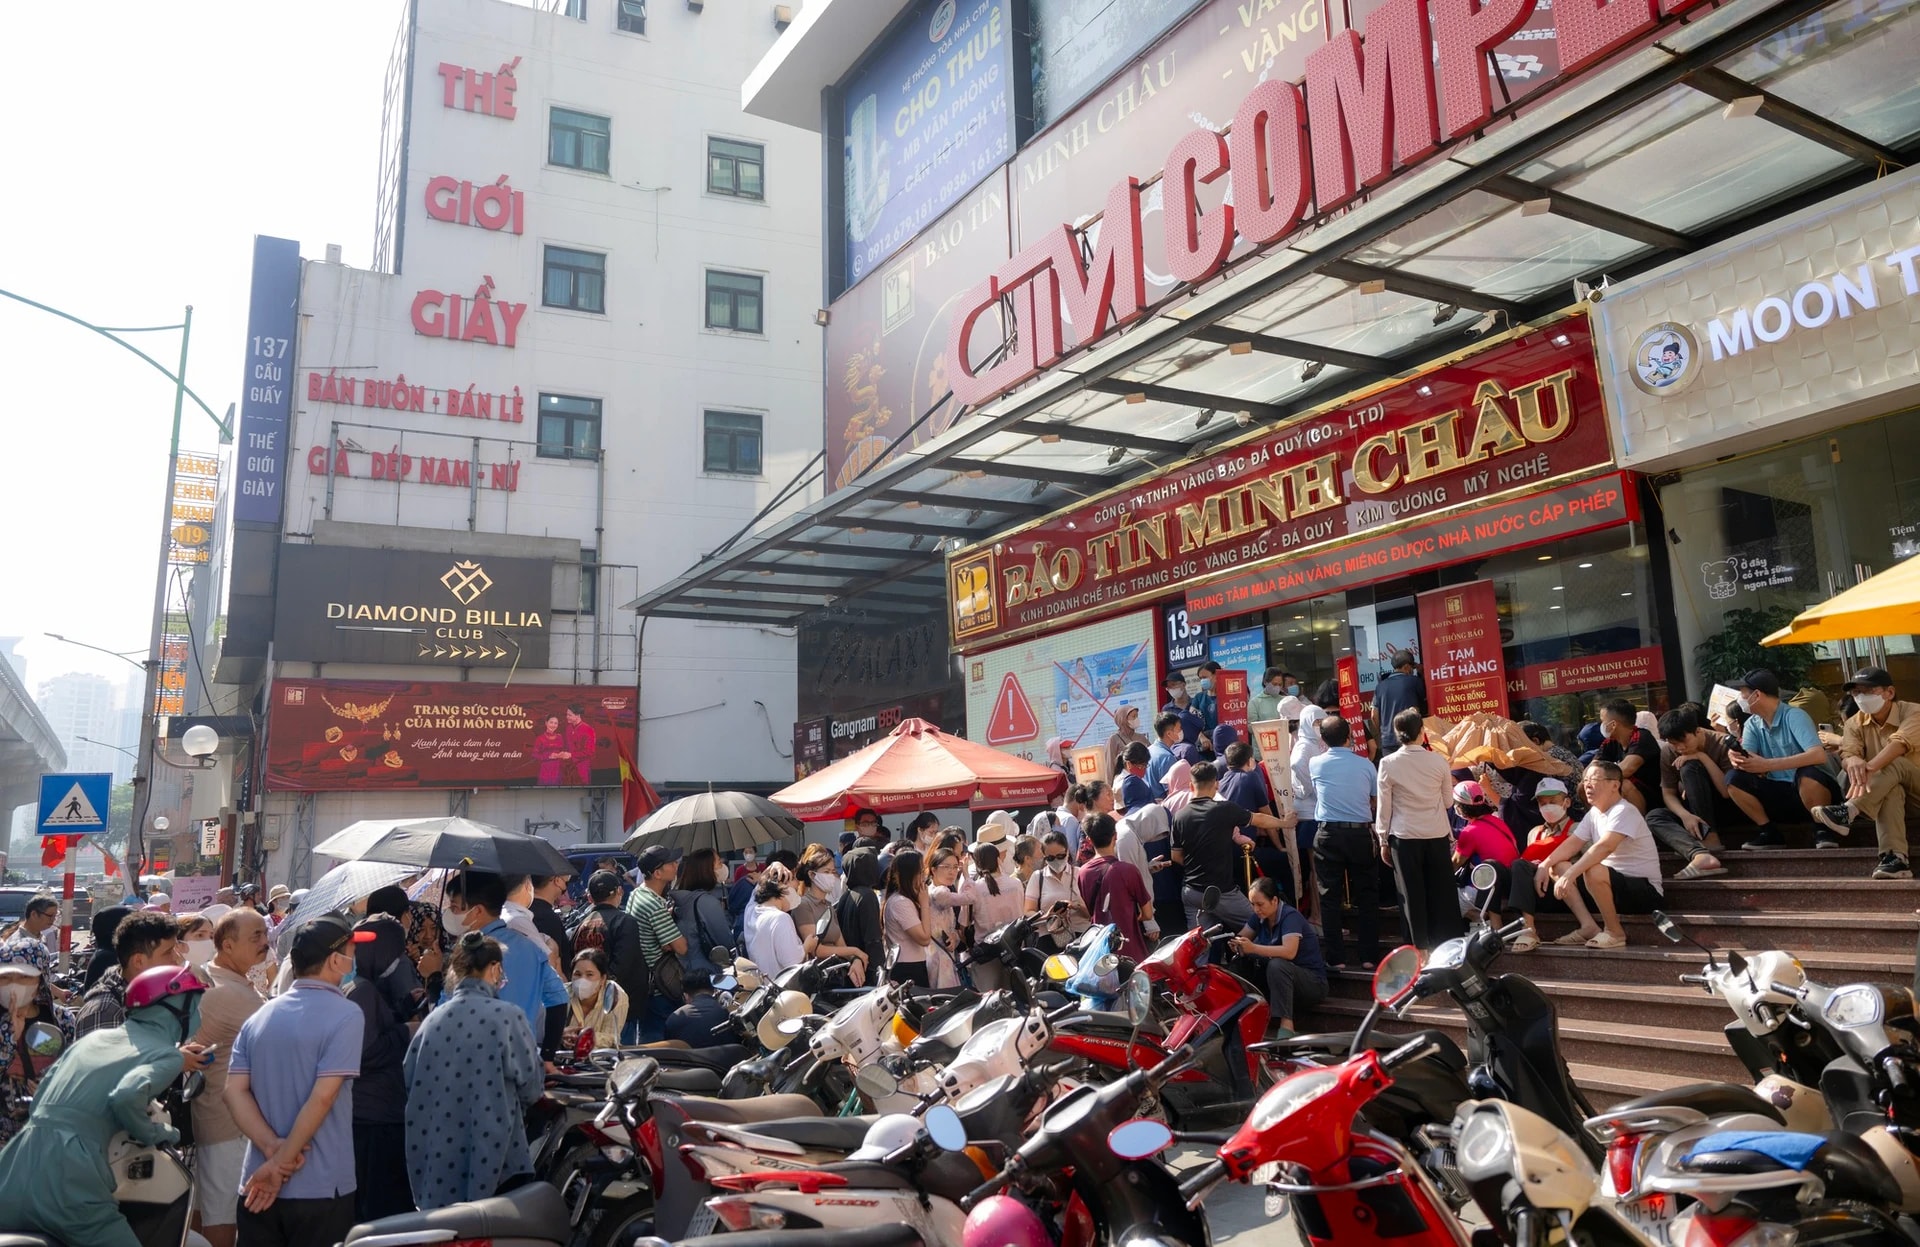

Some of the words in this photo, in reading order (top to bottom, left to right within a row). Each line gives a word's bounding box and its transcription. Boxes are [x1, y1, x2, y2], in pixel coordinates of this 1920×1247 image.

[895, 75, 941, 138] CHO
[946, 5, 1002, 89] THUÊ
[438, 56, 523, 120] THẾ
[952, 63, 999, 119] PHÒNG
[1023, 122, 1089, 191] MINH
[1097, 50, 1177, 134] CHÂU
[424, 174, 524, 236] GIỚI
[411, 274, 528, 348] GIẦY
[1707, 263, 1880, 361] MOON
[253, 335, 288, 359] 137
[307, 366, 356, 405] BÁN
[363, 373, 425, 413] BUÔN
[448, 382, 492, 420] BÁN
[499, 385, 524, 423] LẺ
[248, 431, 278, 451] THẾ
[247, 454, 275, 474] GIỚI
[371, 444, 412, 482] DÉP
[420, 455, 470, 488] NAM
[242, 478, 275, 497] GIÀY
[1003, 541, 1084, 609] BẢO
[1087, 513, 1171, 580] TÍN
[1175, 452, 1342, 554] MINH
[1351, 368, 1579, 495] CHÂU
[1094, 502, 1126, 524] CÔNG
[1146, 483, 1178, 505] TNHH
[1180, 468, 1215, 491] VÀNG
[1217, 457, 1246, 477] BẠC
[1250, 444, 1270, 466] ĐÁ
[1274, 432, 1303, 457] QUÝ
[178, 527, 203, 544] 119
[1020, 606, 1044, 624] KINH
[1046, 596, 1080, 616] DOANH
[1082, 584, 1103, 606] CHẾ
[1105, 581, 1127, 599] TÁC
[1130, 569, 1169, 592] TRANG
[1172, 560, 1198, 579] SỨC
[1204, 550, 1238, 570] VÀNG
[1242, 540, 1268, 559] BẠC
[1281, 527, 1301, 547] ĐÁ
[1304, 517, 1334, 541] QUÝ
[1355, 504, 1384, 527] KIM
[1389, 487, 1447, 516] CƯƠNG
[1463, 469, 1489, 495] MỸ
[1497, 453, 1550, 485] NGHỆ
[1888, 525, 1915, 537] Tiệm
[1187, 593, 1224, 613] TRUNG
[1225, 585, 1249, 603] TÂM
[1251, 579, 1277, 597] MUA
[1278, 570, 1304, 591] BÁN
[1306, 561, 1342, 582] VÀNG
[1438, 525, 1471, 549] NHÀ
[1568, 489, 1618, 517] PHÉP
[1742, 570, 1753, 579] có
[1754, 567, 1769, 578] trà
[1743, 581, 1767, 592] ngon
[326, 602, 457, 625] DIAMOND
[465, 608, 543, 628] BILLIA
[436, 627, 484, 640] CLUB
[1447, 646, 1475, 663] TẠM
[1430, 663, 1455, 681] HẾT
[1458, 659, 1498, 676] HÀNG
[1561, 668, 1579, 678] BẢO
[1580, 663, 1597, 676] TÍN
[1597, 661, 1622, 673] MINH
[1623, 656, 1650, 669] CHÂU
[1223, 701, 1246, 710] GOLD
[1445, 693, 1466, 703] VÀNG
[1462, 702, 1481, 712] LONG
[413, 704, 460, 716] TRANG
[462, 703, 489, 716] SỨC
[404, 715, 433, 728] CỦA
[463, 716, 494, 729] MÔN
[496, 719, 534, 730] BTMC
[830, 716, 876, 739] Gangnam
[878, 706, 902, 728] BBQ
[882, 793, 914, 803] Hotline:
[1008, 787, 1045, 795] www.btmc.vn
